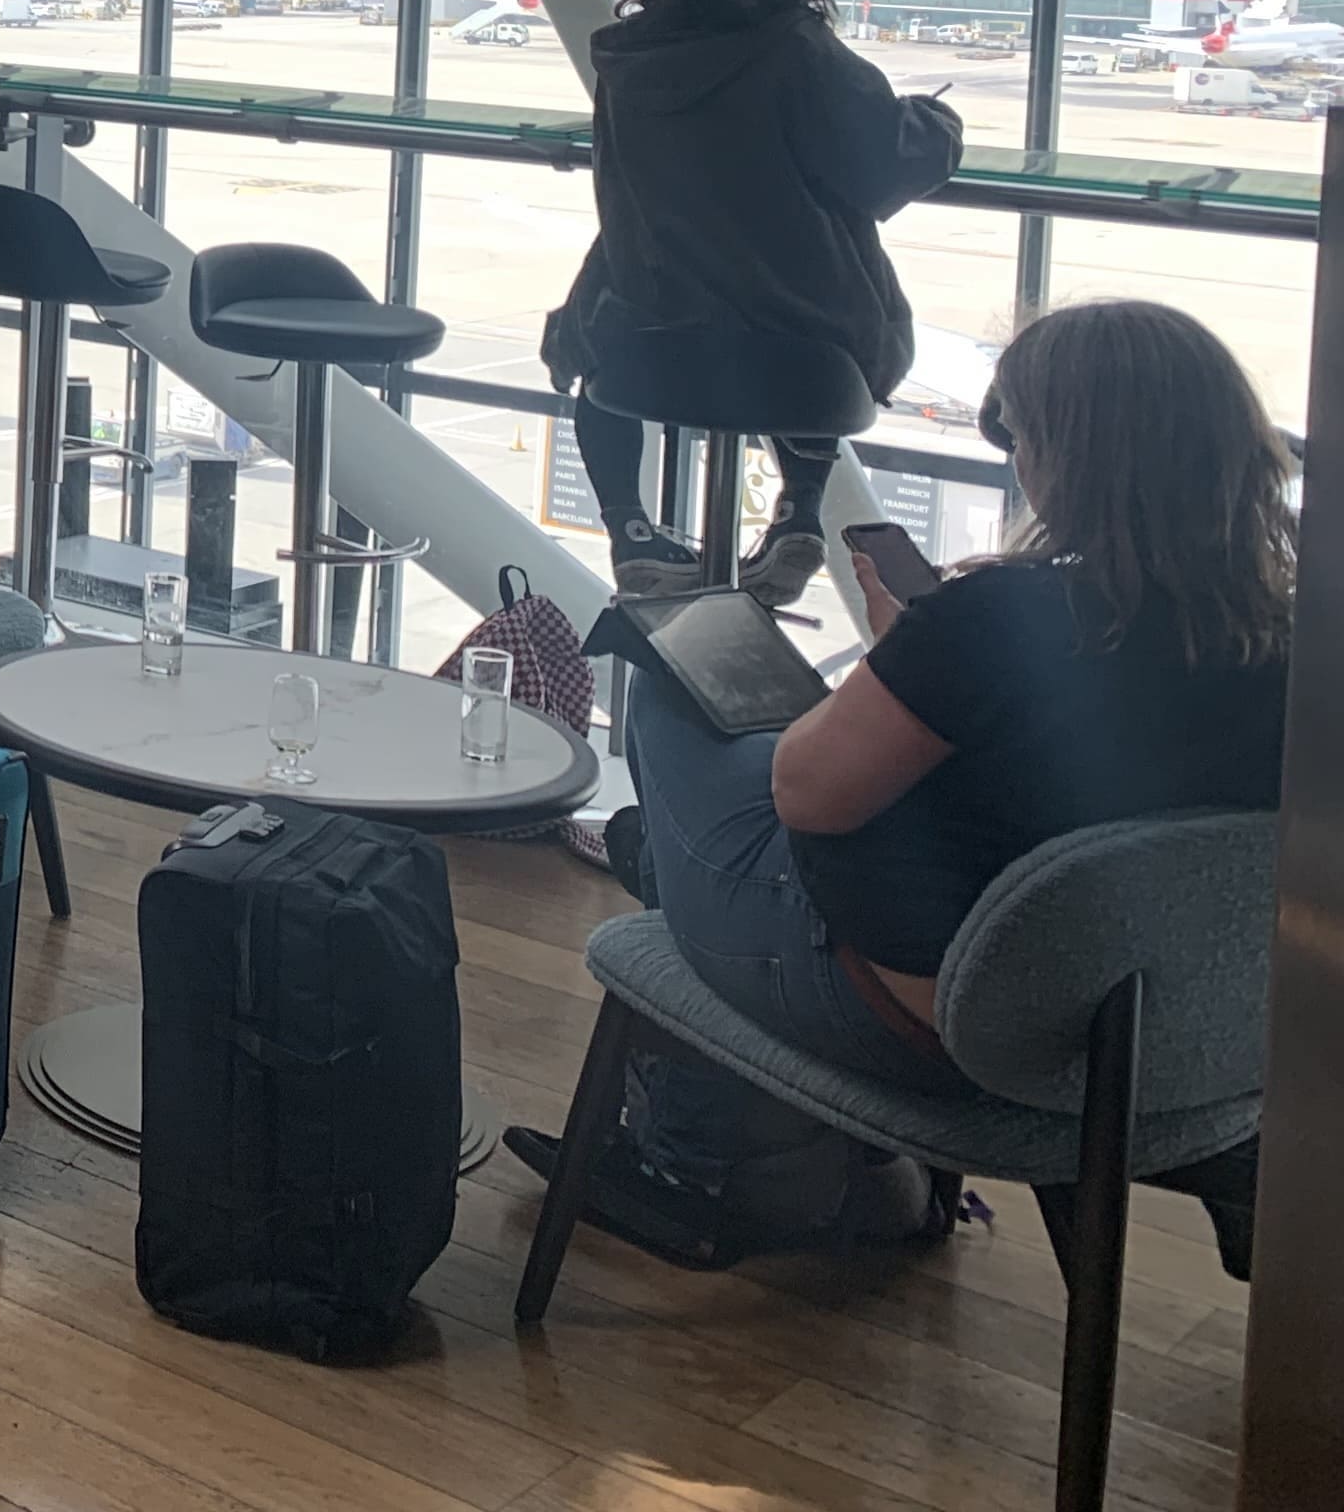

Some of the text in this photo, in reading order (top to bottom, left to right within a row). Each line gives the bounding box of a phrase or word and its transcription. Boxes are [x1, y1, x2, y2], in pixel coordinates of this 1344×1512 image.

[555, 471, 576, 481] PARIS
[554, 485, 587, 496] ISTANBUL
[898, 487, 930, 499] MUNICH
[553, 498, 576, 508] MILAN
[884, 499, 928, 513] FRANKFURT
[552, 511, 592, 525] BARCELONA
